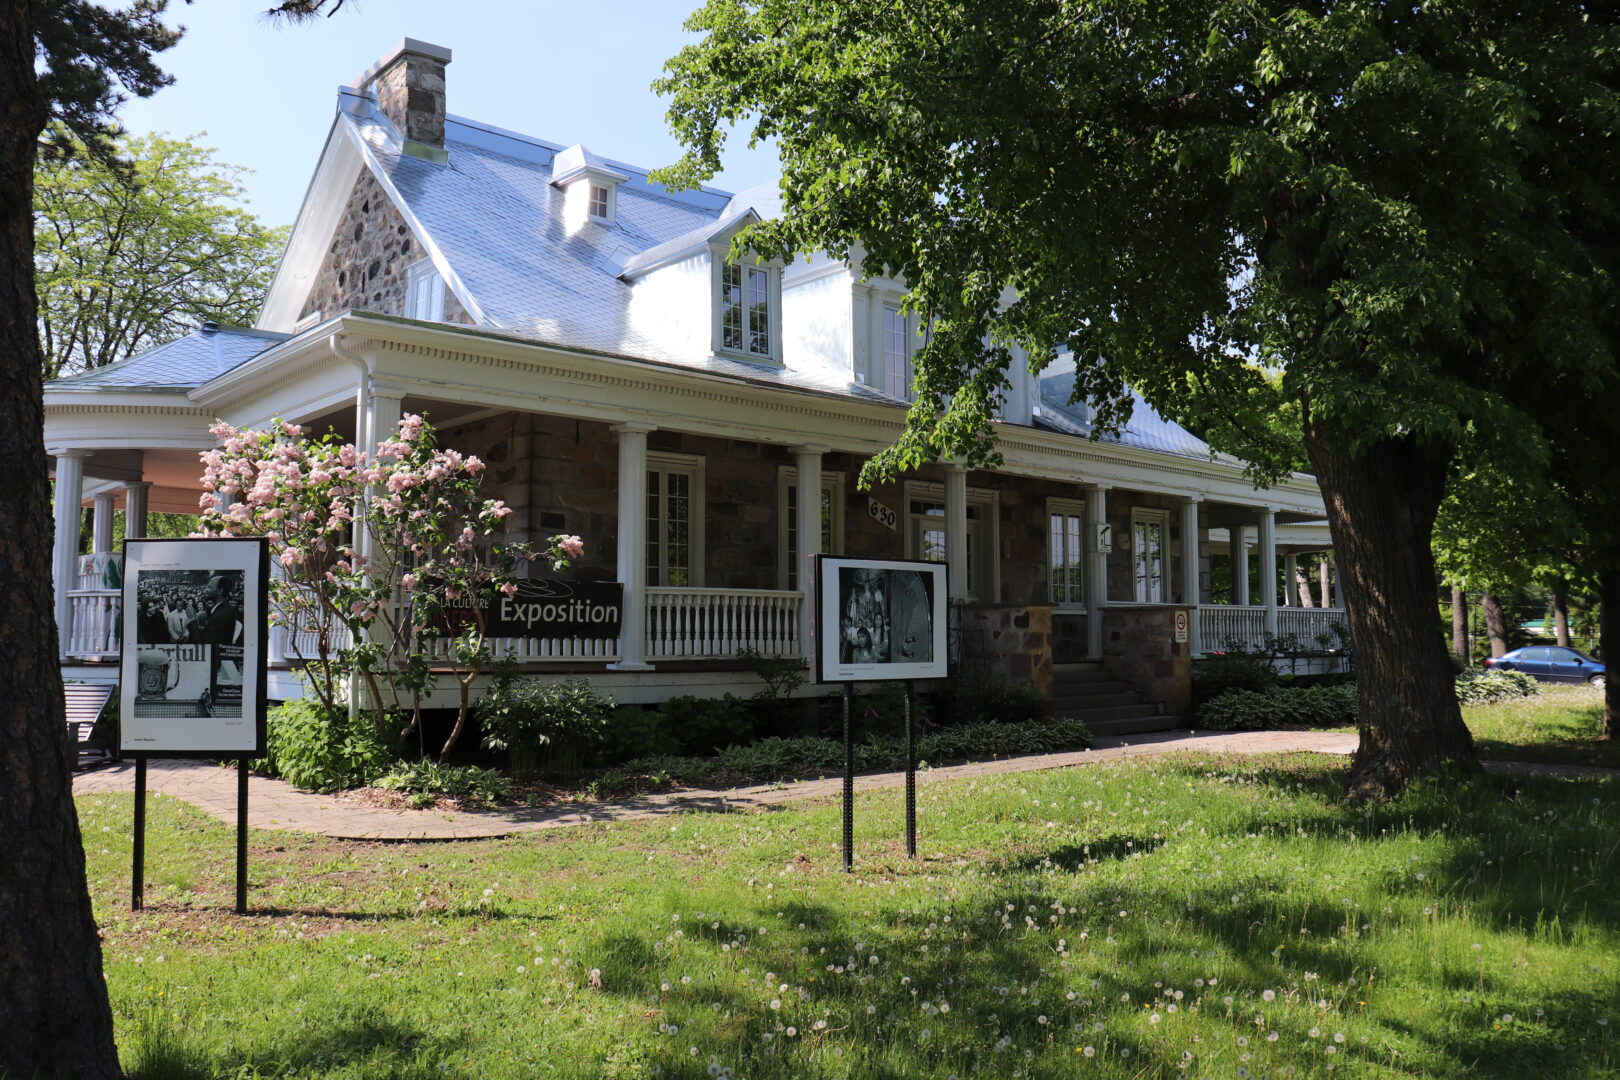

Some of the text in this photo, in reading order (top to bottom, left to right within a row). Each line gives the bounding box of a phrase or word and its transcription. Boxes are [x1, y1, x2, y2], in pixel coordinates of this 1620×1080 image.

[871, 501, 895, 526] 630
[452, 598, 489, 609] CULTRE
[500, 597, 618, 629] Exposition
